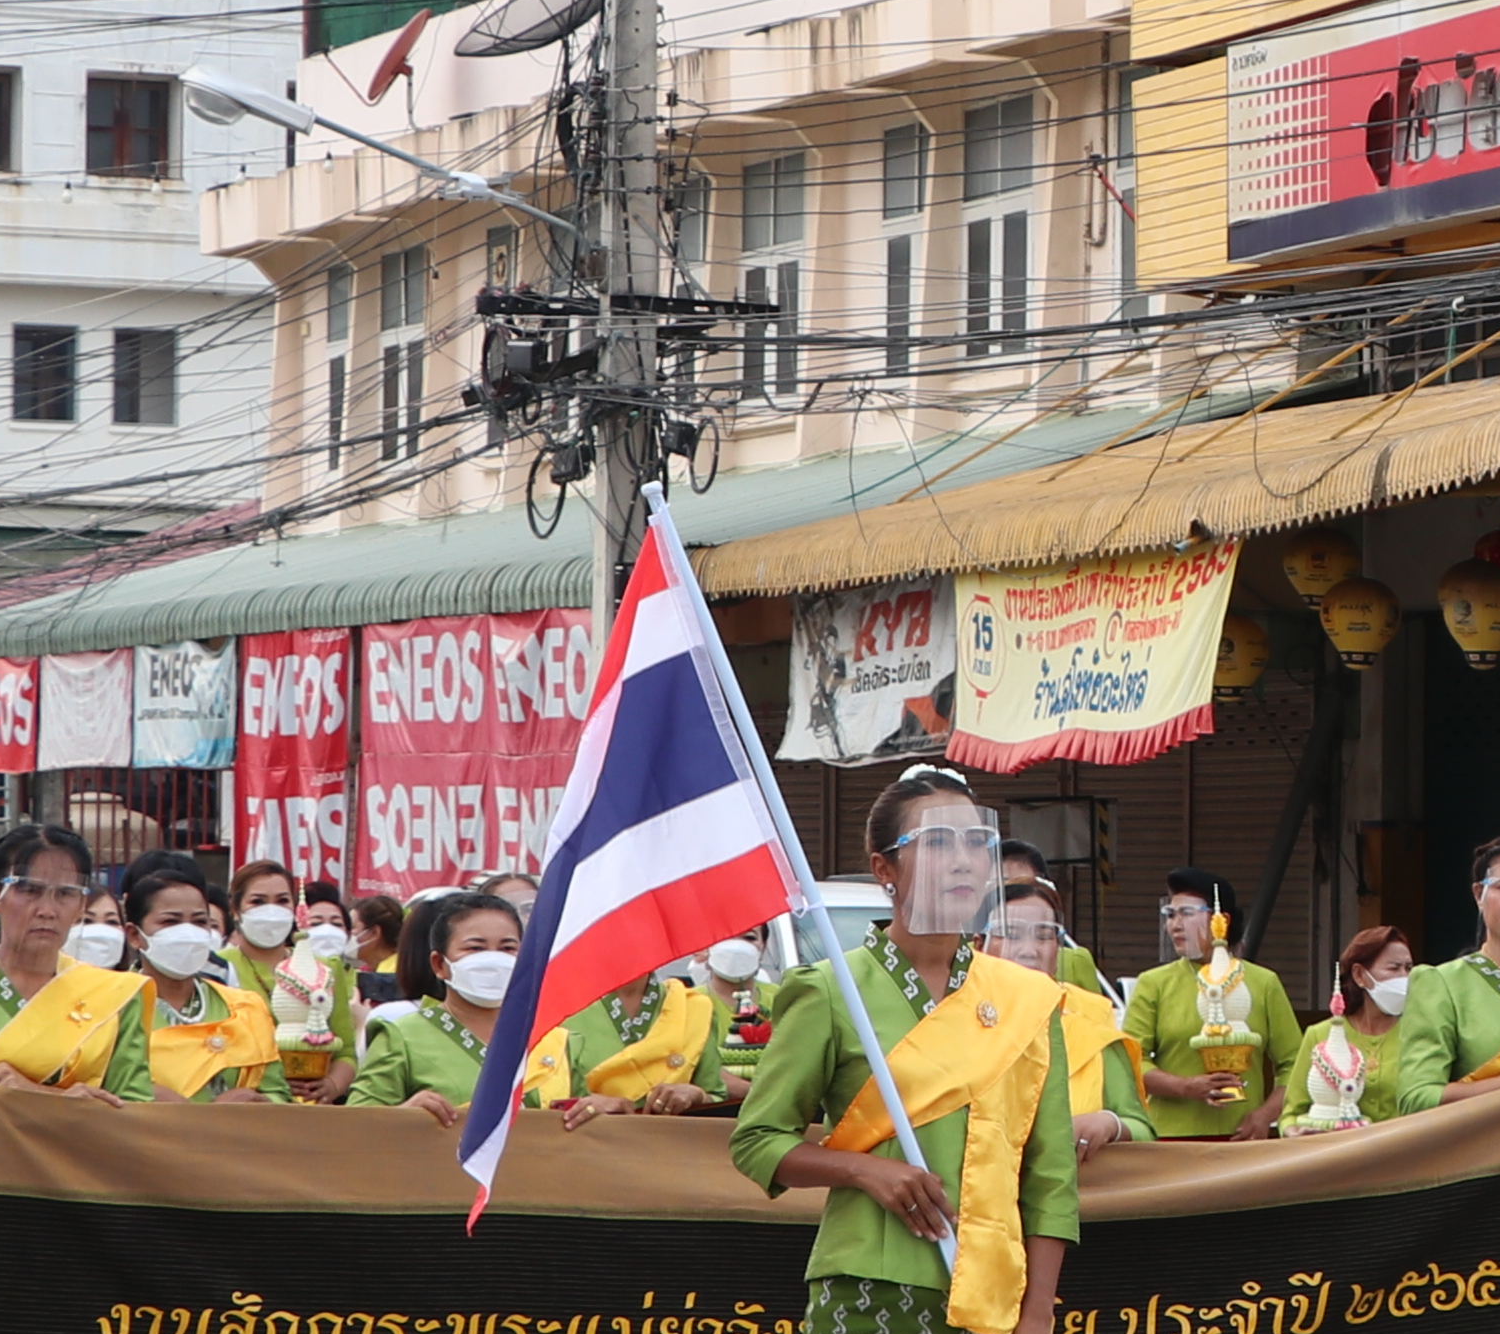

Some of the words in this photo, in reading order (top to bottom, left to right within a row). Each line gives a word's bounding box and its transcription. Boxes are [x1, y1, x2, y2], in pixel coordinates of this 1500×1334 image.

[1169, 534, 1236, 604] 2565
[491, 624, 594, 723] ENEO
[972, 611, 993, 653] 15
[244, 651, 344, 739] ENEOS
[368, 630, 484, 723] ENEOS
